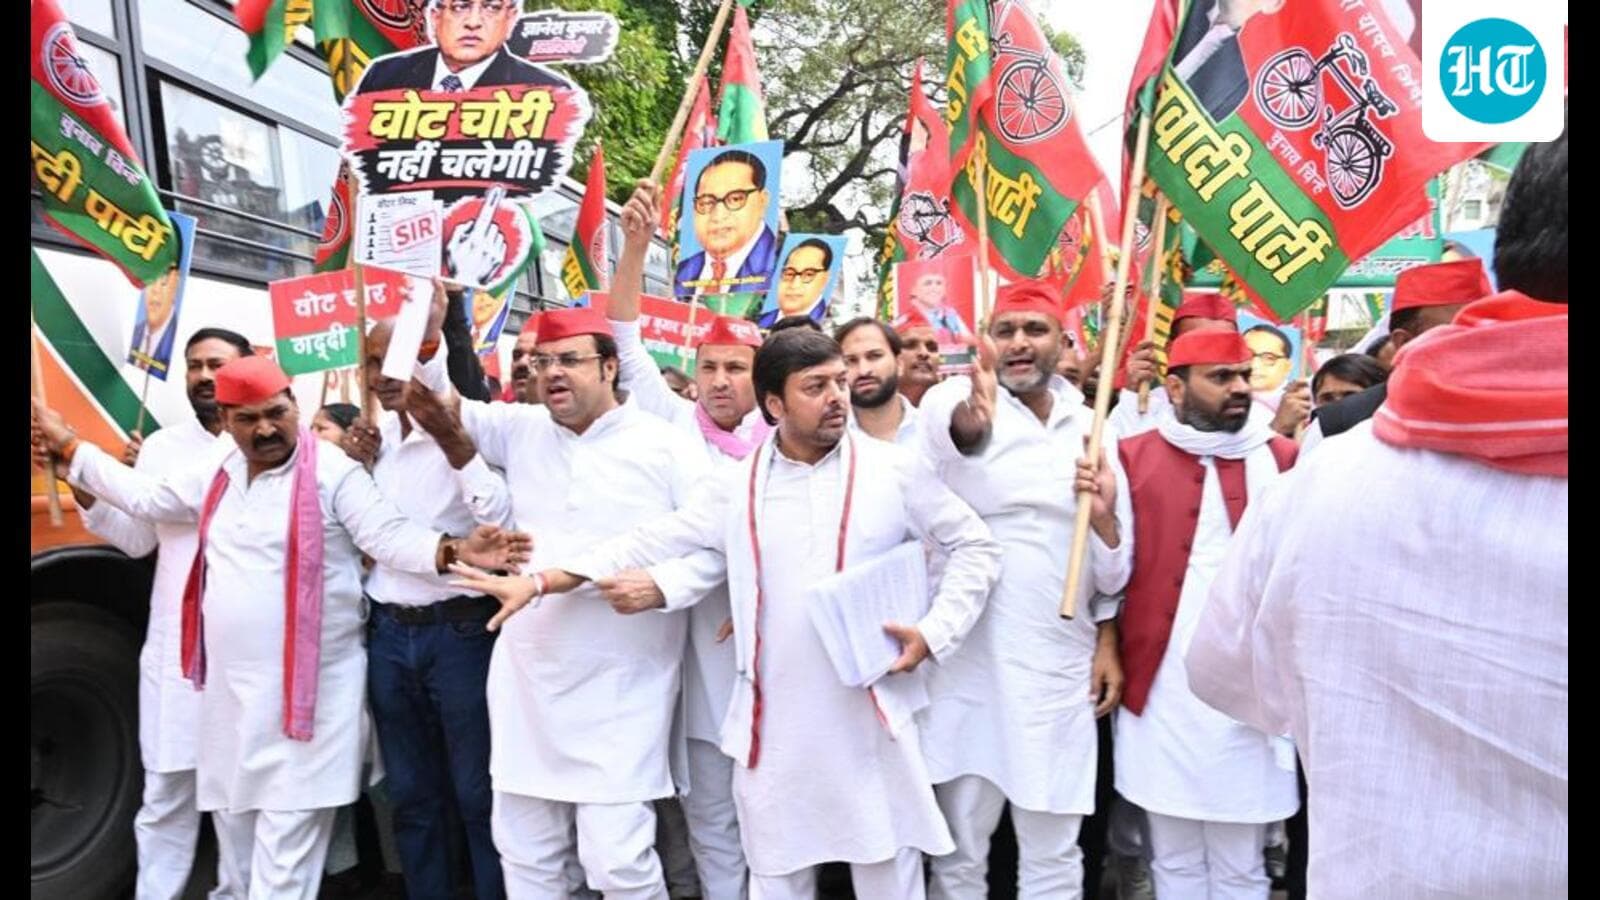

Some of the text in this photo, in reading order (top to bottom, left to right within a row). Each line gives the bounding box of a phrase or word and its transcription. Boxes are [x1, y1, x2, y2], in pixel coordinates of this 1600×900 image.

[368, 88, 556, 140] वोट चोरी
[376, 138, 548, 182] नहीं चलेगी!
[1265, 129, 1303, 168] चुनाव
[84, 187, 173, 262] पार्टी
[395, 216, 434, 247] SIR
[1228, 178, 1334, 285] पार्टी
[292, 288, 338, 318] वोट
